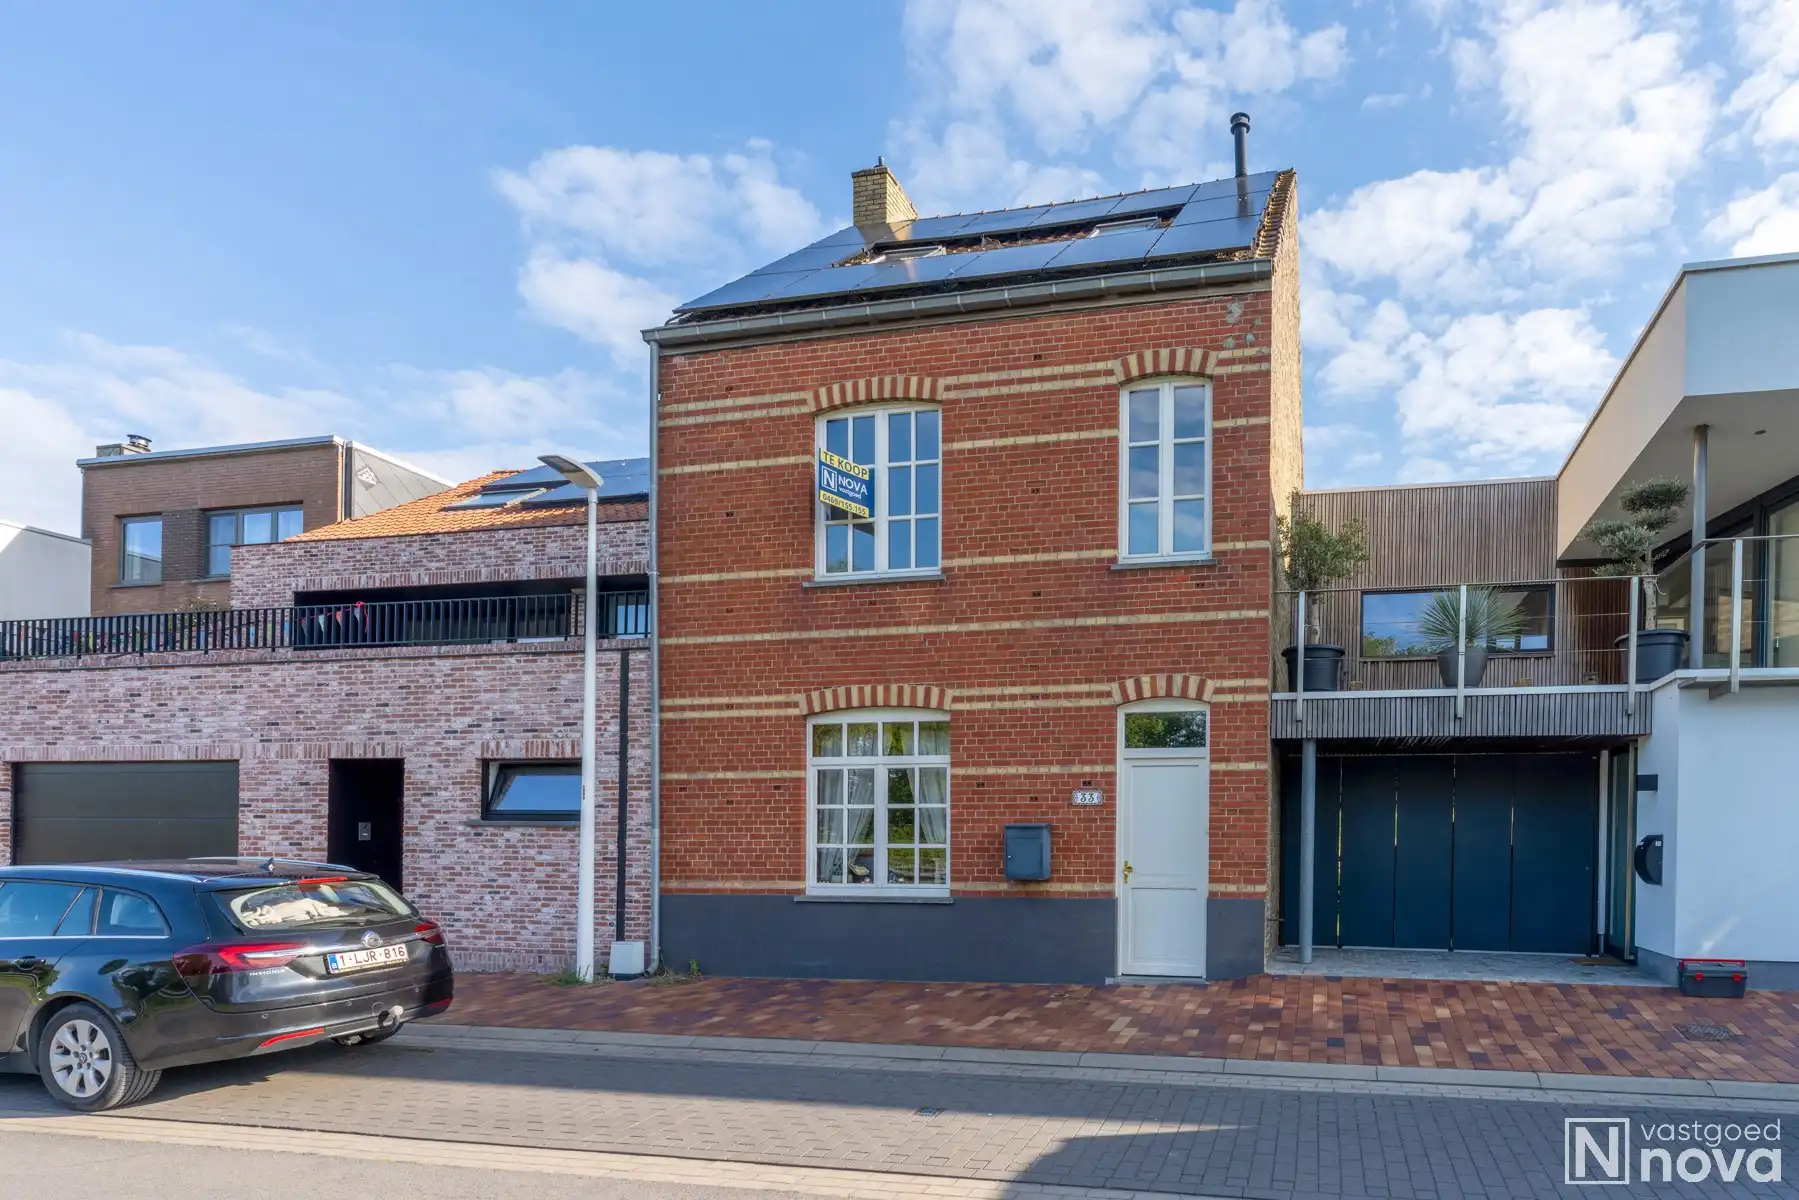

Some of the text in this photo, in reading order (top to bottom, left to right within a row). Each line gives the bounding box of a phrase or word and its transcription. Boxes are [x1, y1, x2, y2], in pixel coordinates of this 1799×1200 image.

[823, 451, 868, 477] TE KOOP
[838, 475, 868, 495] NOVA
[1080, 793, 1094, 802] 33
